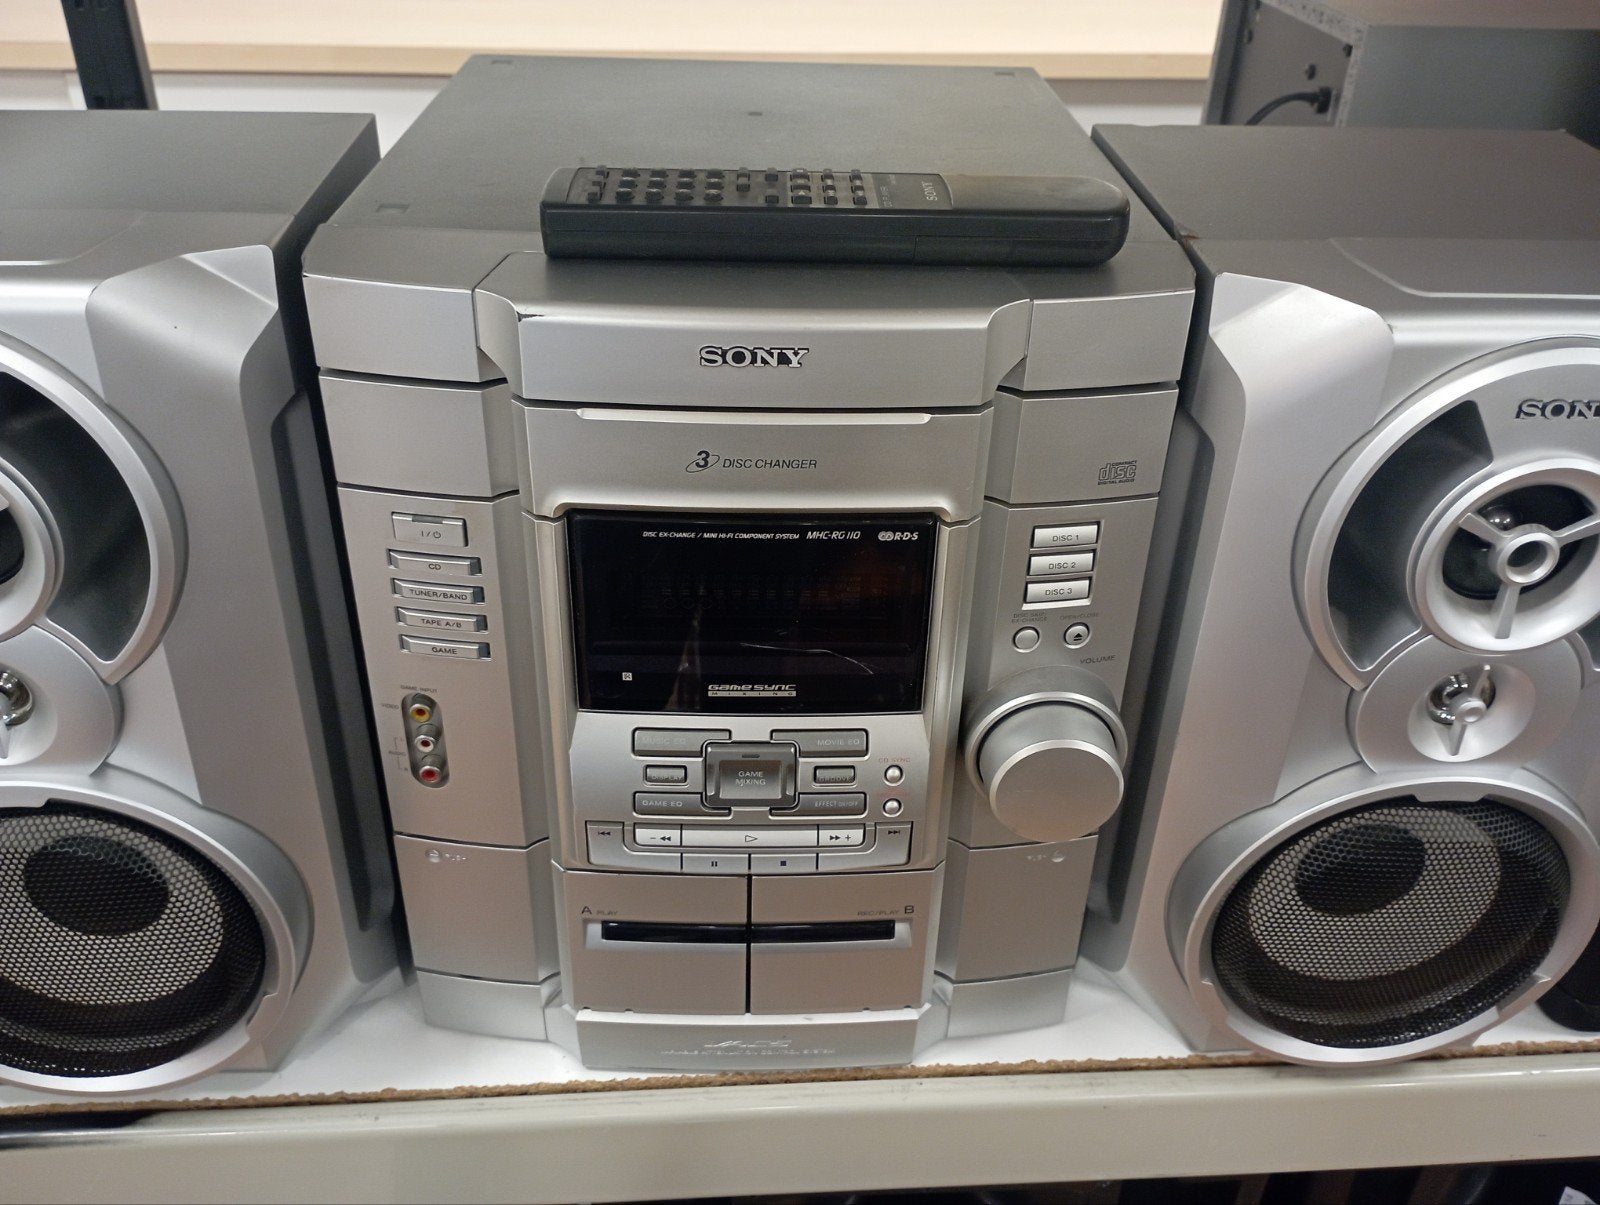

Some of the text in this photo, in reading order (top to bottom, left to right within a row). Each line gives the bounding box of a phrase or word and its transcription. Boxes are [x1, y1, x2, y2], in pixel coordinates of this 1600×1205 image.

[699, 345, 810, 368] SONY
[695, 450, 818, 470] 3 DISC CHANGER
[1098, 463, 1137, 481] disc
[734, 532, 774, 540] COMPONENT
[1052, 534, 1073, 542] DISC
[428, 563, 442, 571] CD
[1048, 561, 1076, 570] DISC 2
[409, 588, 468, 601] TUNER/BAND
[1044, 588, 1065, 596] DISC
[421, 618, 462, 628] TAPE A/B
[431, 646, 458, 655] GAME
[1079, 655, 1117, 665] VOLUME
[817, 738, 845, 746] MOVIE
[738, 770, 764, 778] GAME
[735, 778, 766, 786] MIXING
[642, 799, 683, 808] GAME EQ
[581, 905, 593, 915] A
[904, 904, 915, 914] B
